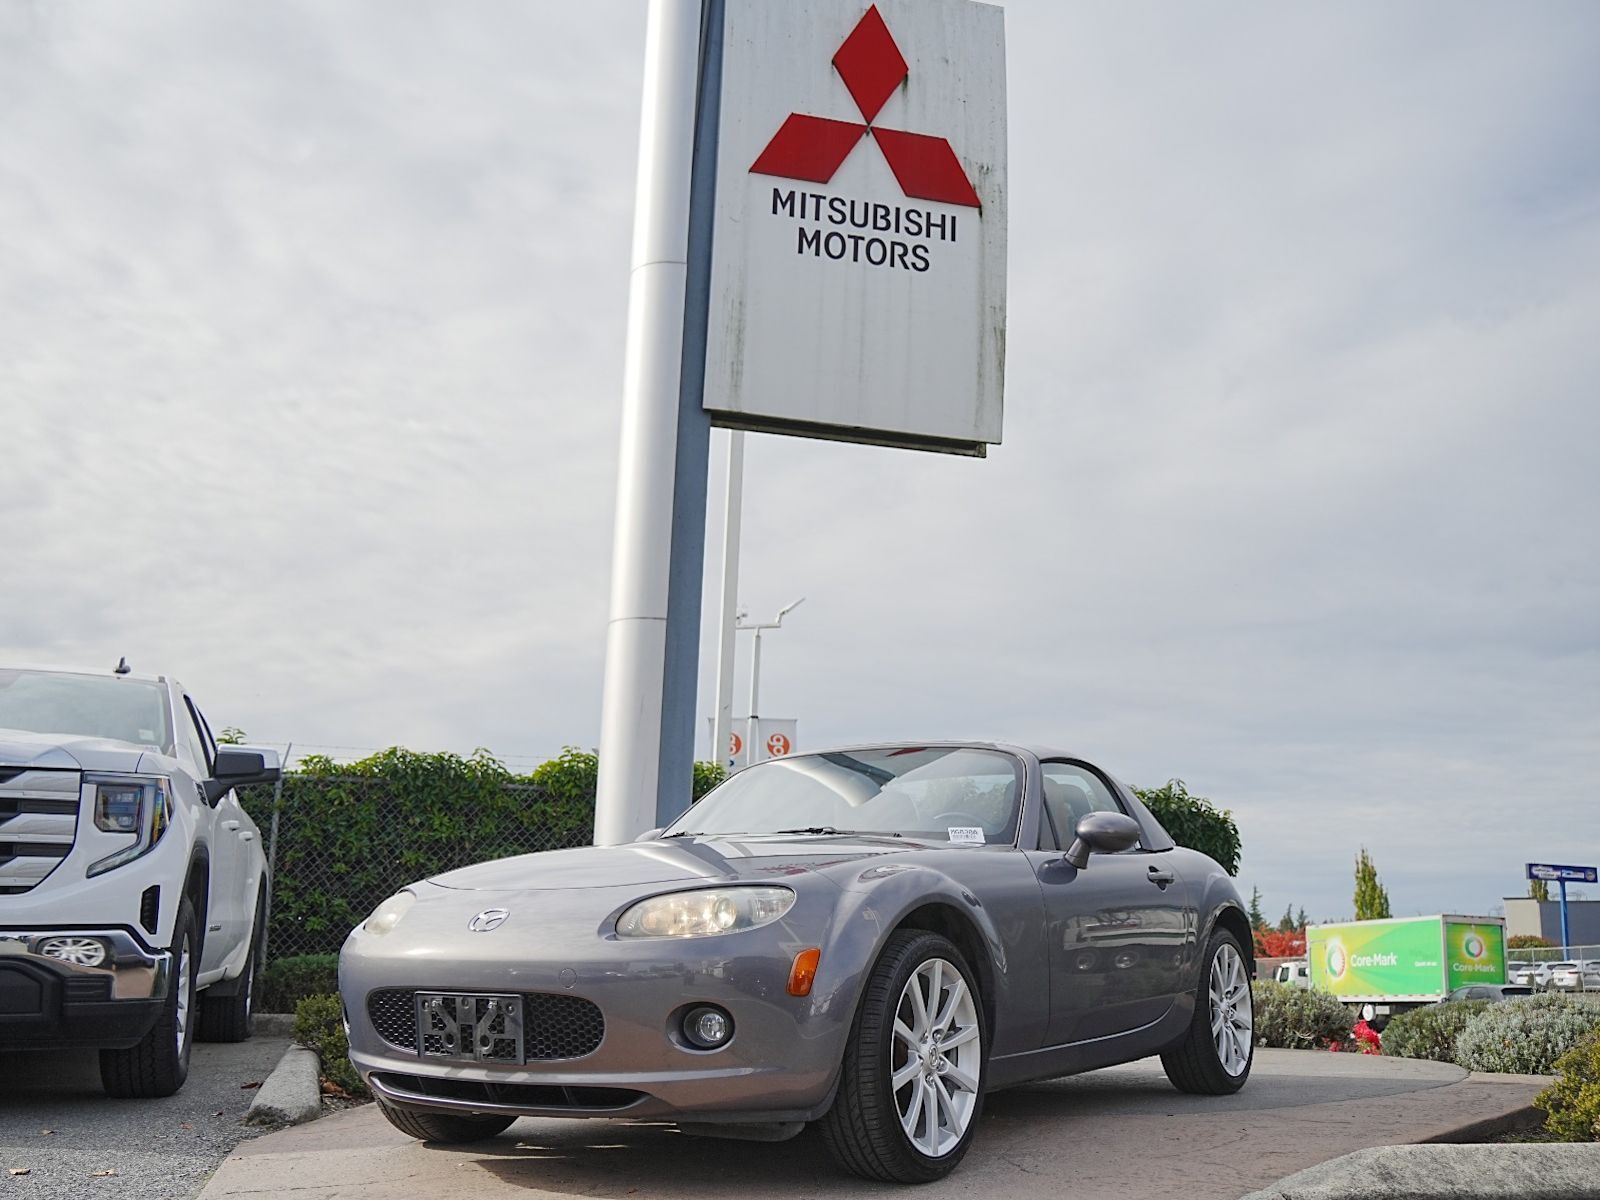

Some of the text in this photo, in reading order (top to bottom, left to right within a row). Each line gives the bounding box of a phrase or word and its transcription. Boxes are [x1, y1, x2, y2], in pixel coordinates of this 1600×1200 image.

[772, 188, 956, 242] MITSUBISHI
[798, 226, 930, 272] MOTORS
[1350, 952, 1398, 967] Core-Mark
[1452, 962, 1496, 973] Core-Mark
